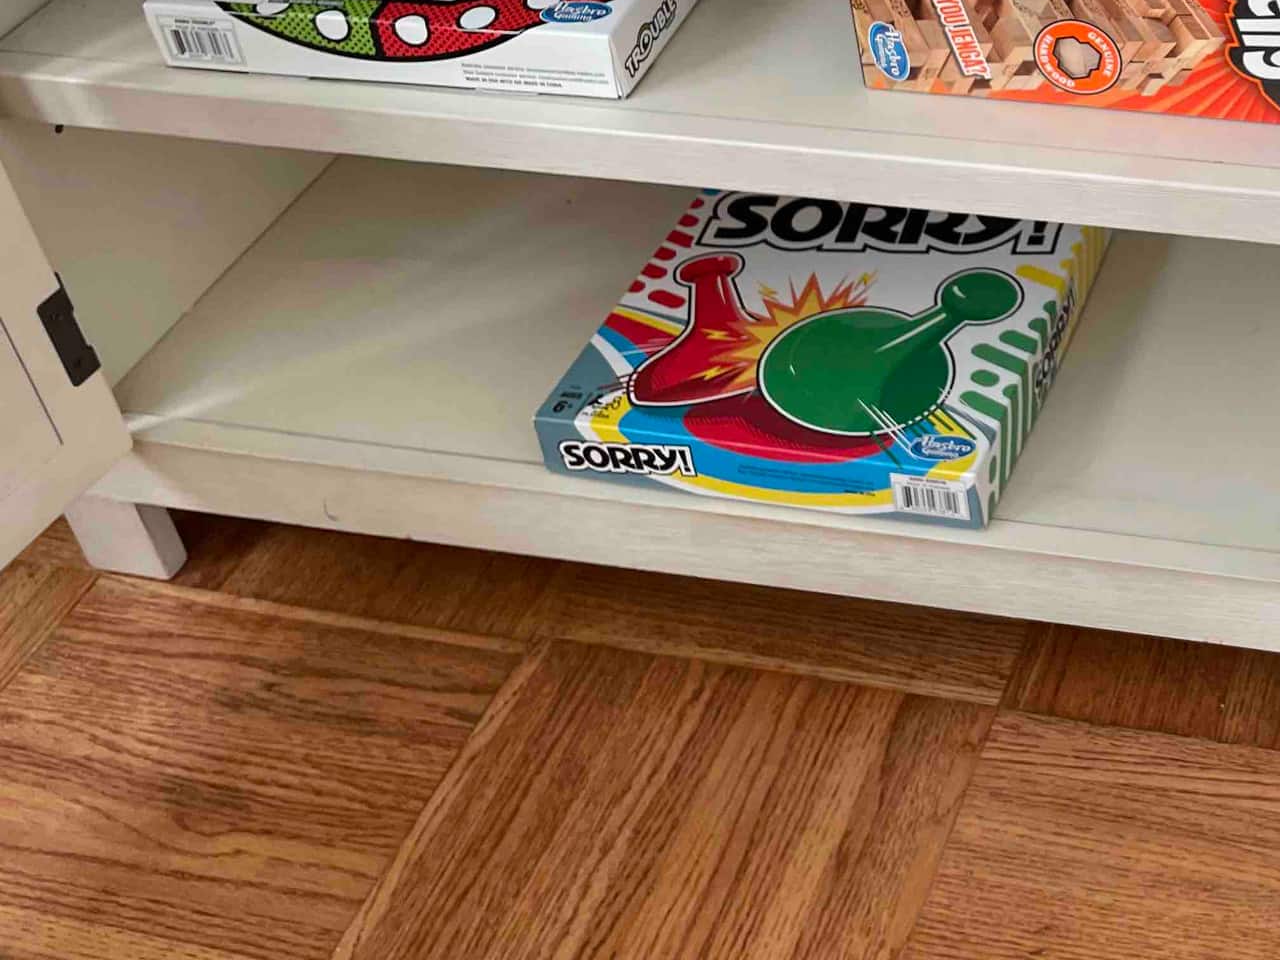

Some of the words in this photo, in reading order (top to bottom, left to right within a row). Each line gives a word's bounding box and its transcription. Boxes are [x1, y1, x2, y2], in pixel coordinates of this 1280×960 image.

[554, 2, 607, 17] Hasbro
[555, 12, 592, 23] Gaming
[886, 27, 900, 75] Hasbro
[950, 26, 988, 76] JENGA?
[1088, 31, 1115, 77] GENUINE
[920, 434, 973, 451] Hasbro
[563, 444, 693, 473] SORRY!
